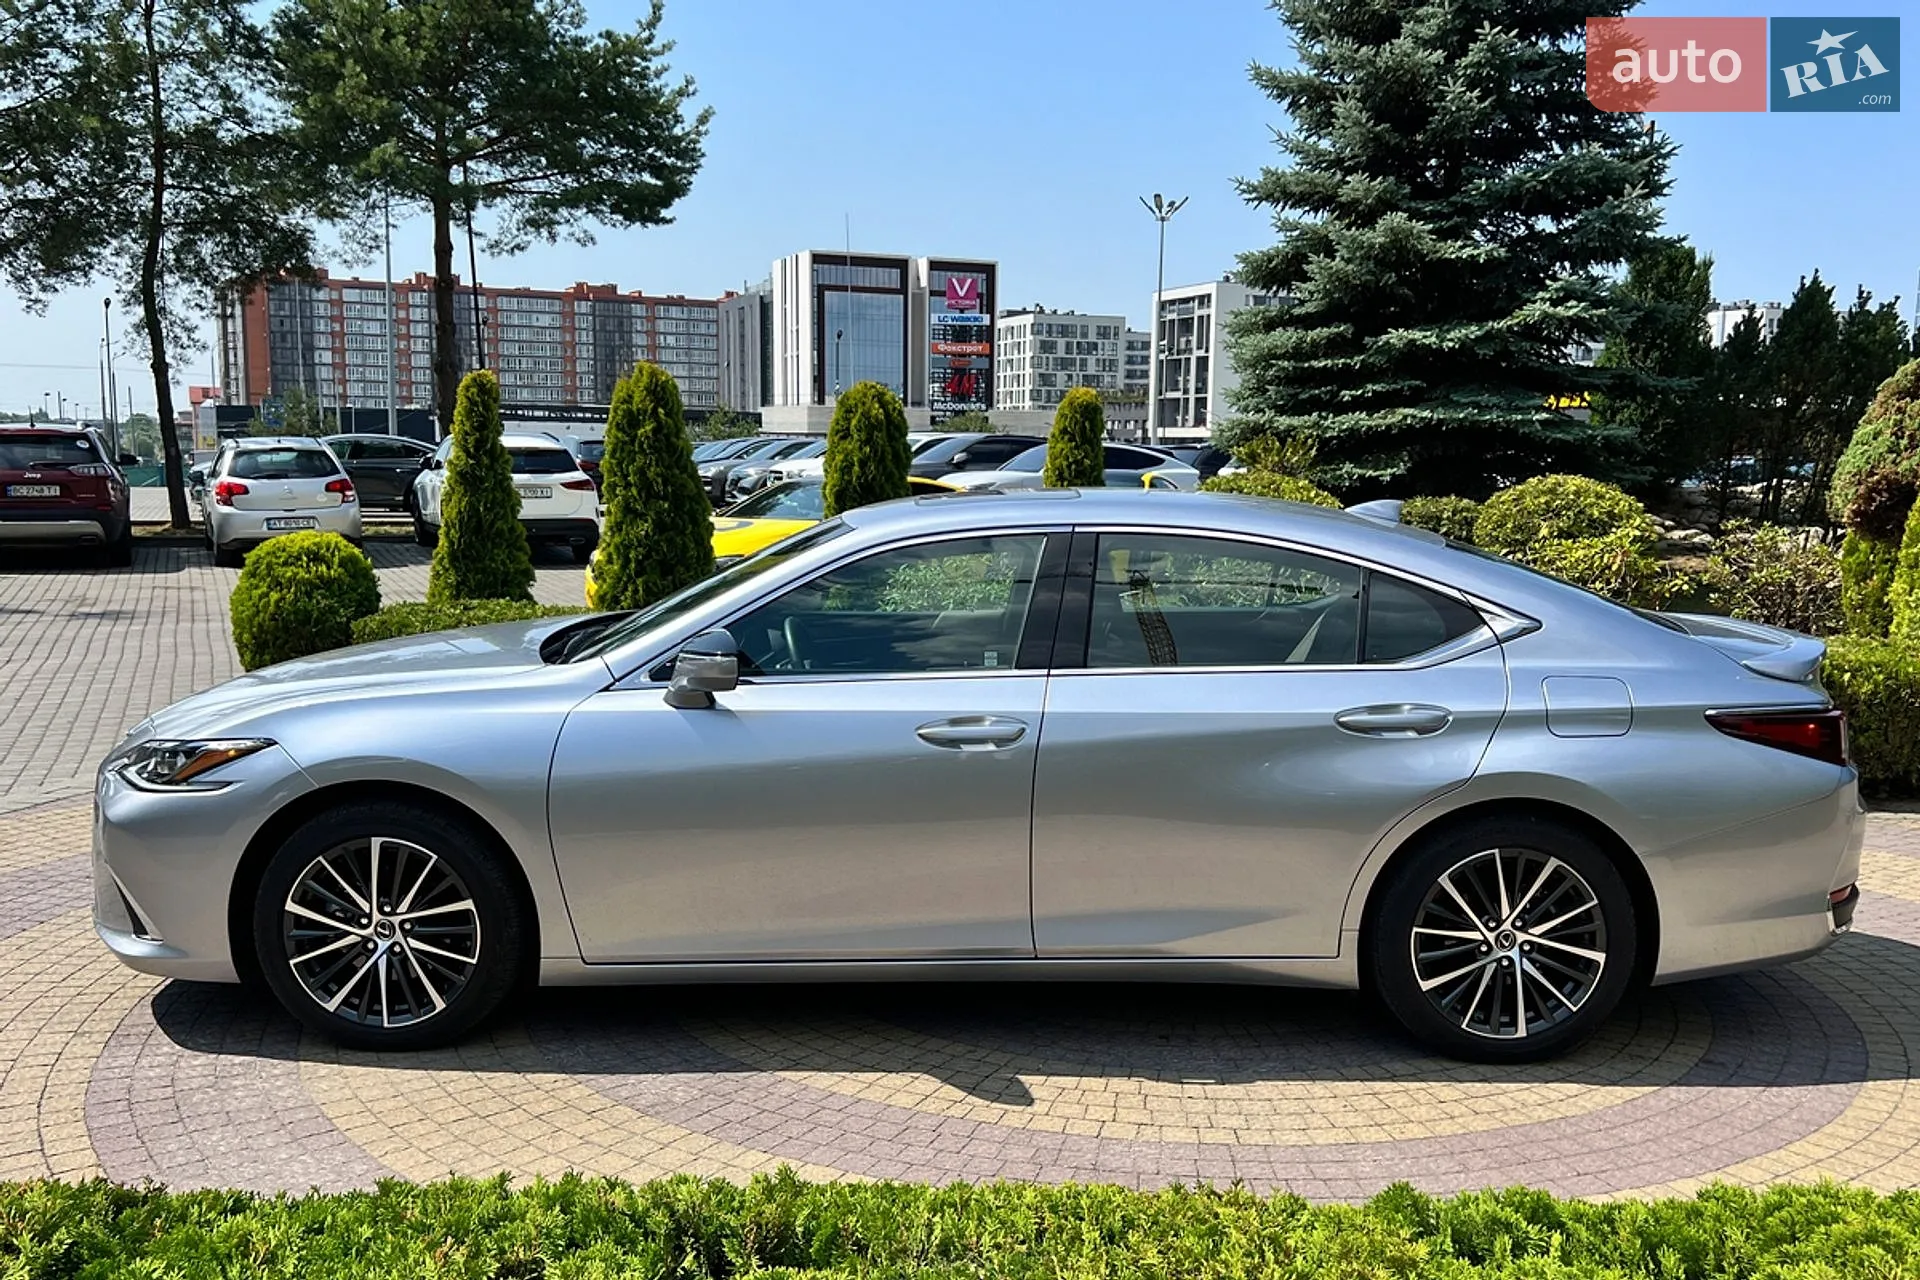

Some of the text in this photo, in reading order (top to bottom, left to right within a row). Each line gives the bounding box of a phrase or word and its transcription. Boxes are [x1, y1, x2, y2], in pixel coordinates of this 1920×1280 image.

[951, 277, 973, 297] V
[937, 315, 949, 323] LC
[937, 344, 983, 353] Фокстрот
[933, 402, 986, 411] McDonald's
[23, 471, 42, 479] Jeep
